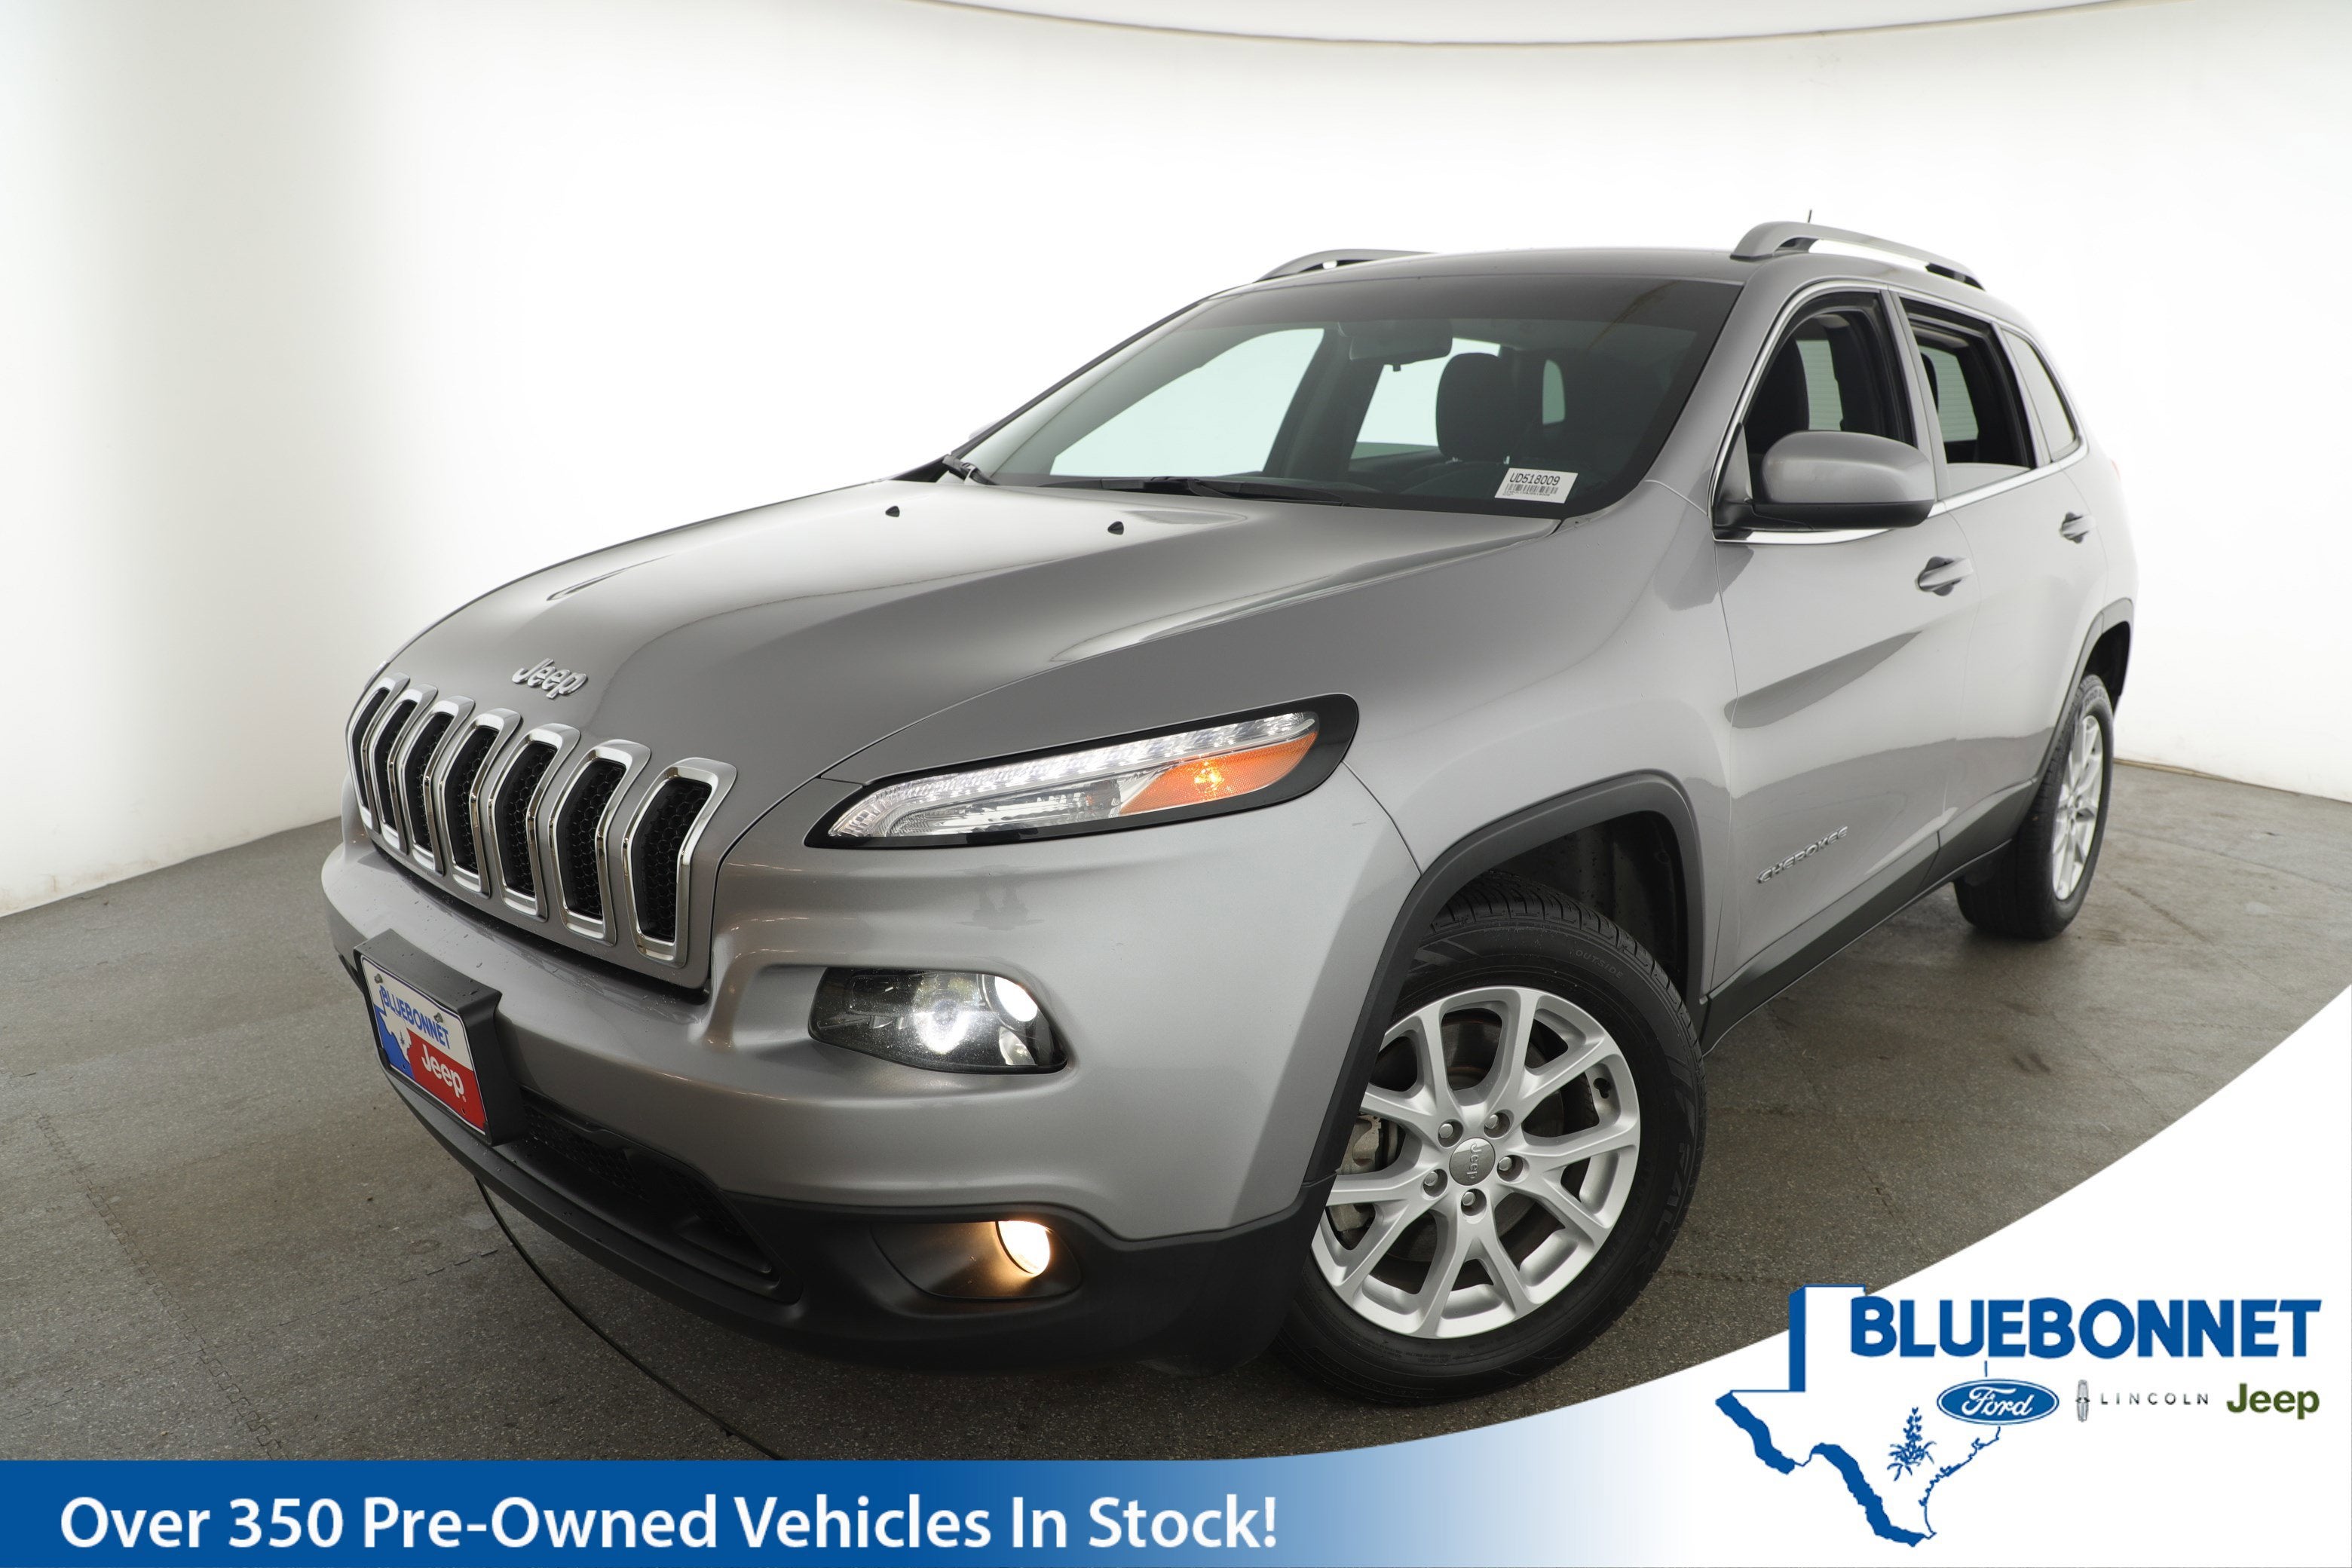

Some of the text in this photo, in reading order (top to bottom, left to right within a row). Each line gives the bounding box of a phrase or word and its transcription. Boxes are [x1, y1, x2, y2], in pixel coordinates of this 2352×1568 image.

[512, 657, 587, 700] Jeep
[1756, 825, 1848, 883] CHEROKEE
[1575, 948, 1624, 979] OUTSIDE
[379, 985, 450, 1049] BLUEBONNET
[421, 1043, 465, 1098] Jeep
[1466, 1143, 1482, 1179] Jeep
